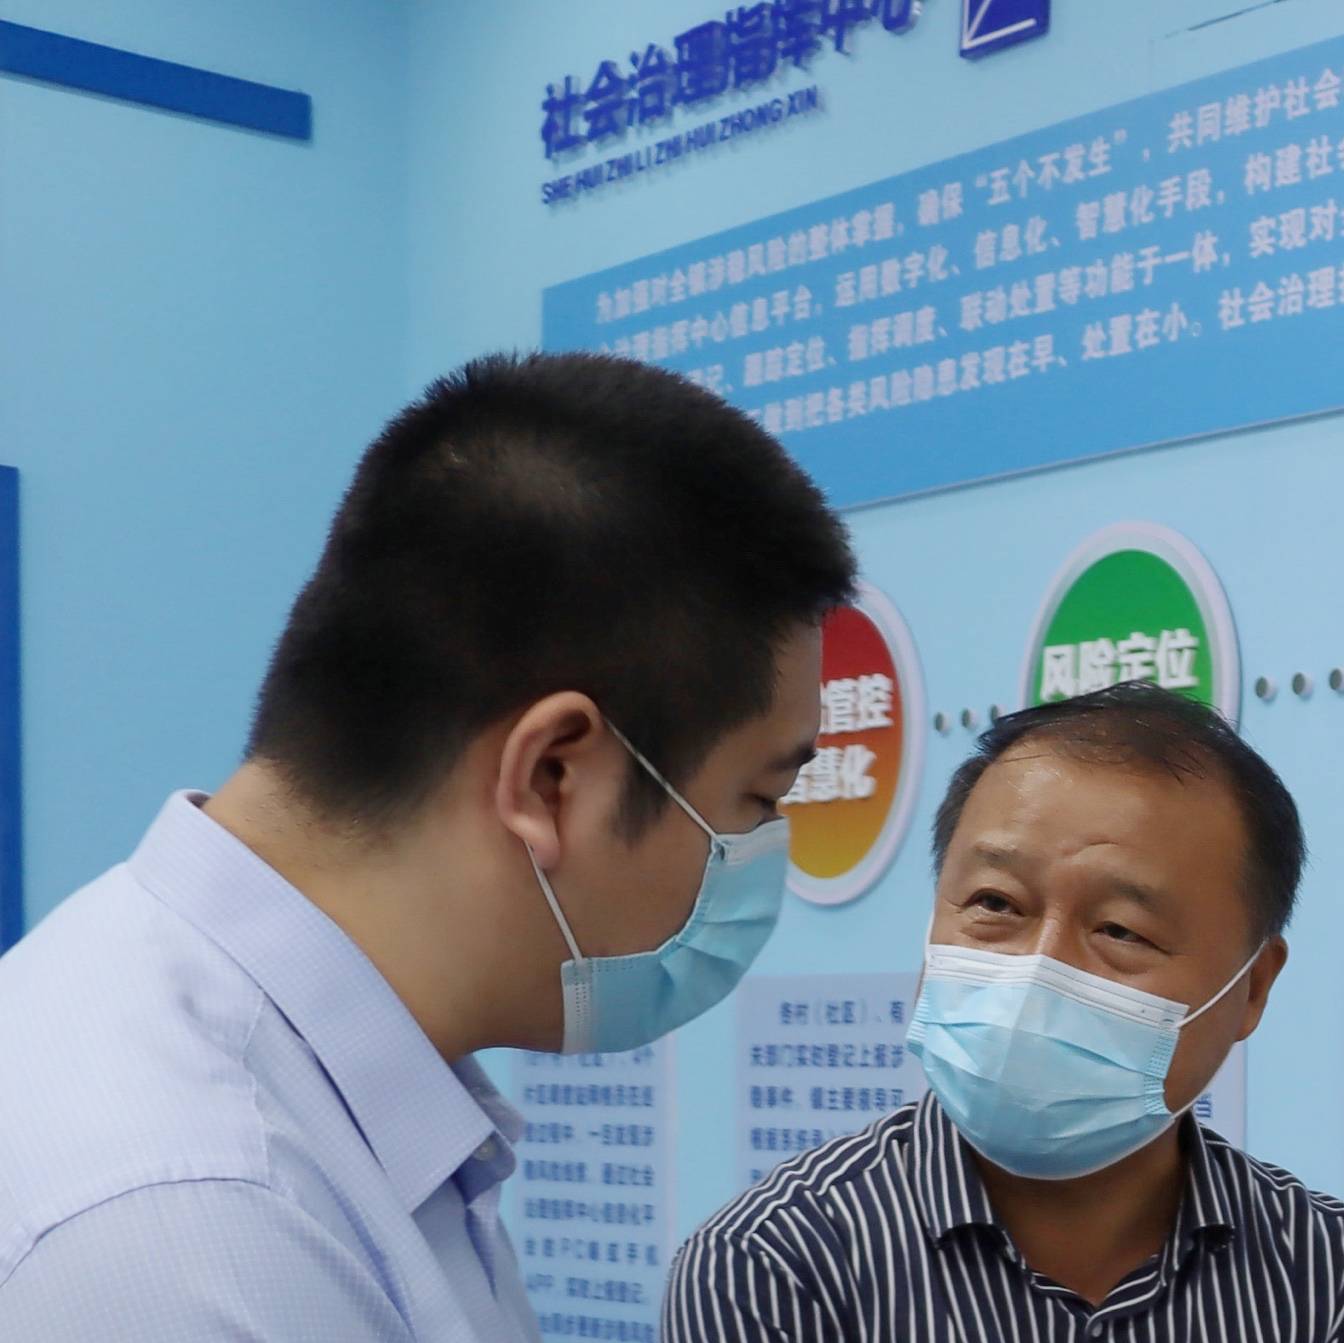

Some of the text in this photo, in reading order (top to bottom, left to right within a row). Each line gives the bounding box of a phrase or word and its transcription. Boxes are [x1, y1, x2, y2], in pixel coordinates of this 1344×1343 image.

[718, 98, 784, 142] ZHONG
[787, 85, 819, 117] XIN
[1040, 627, 1200, 702] 风险定位
